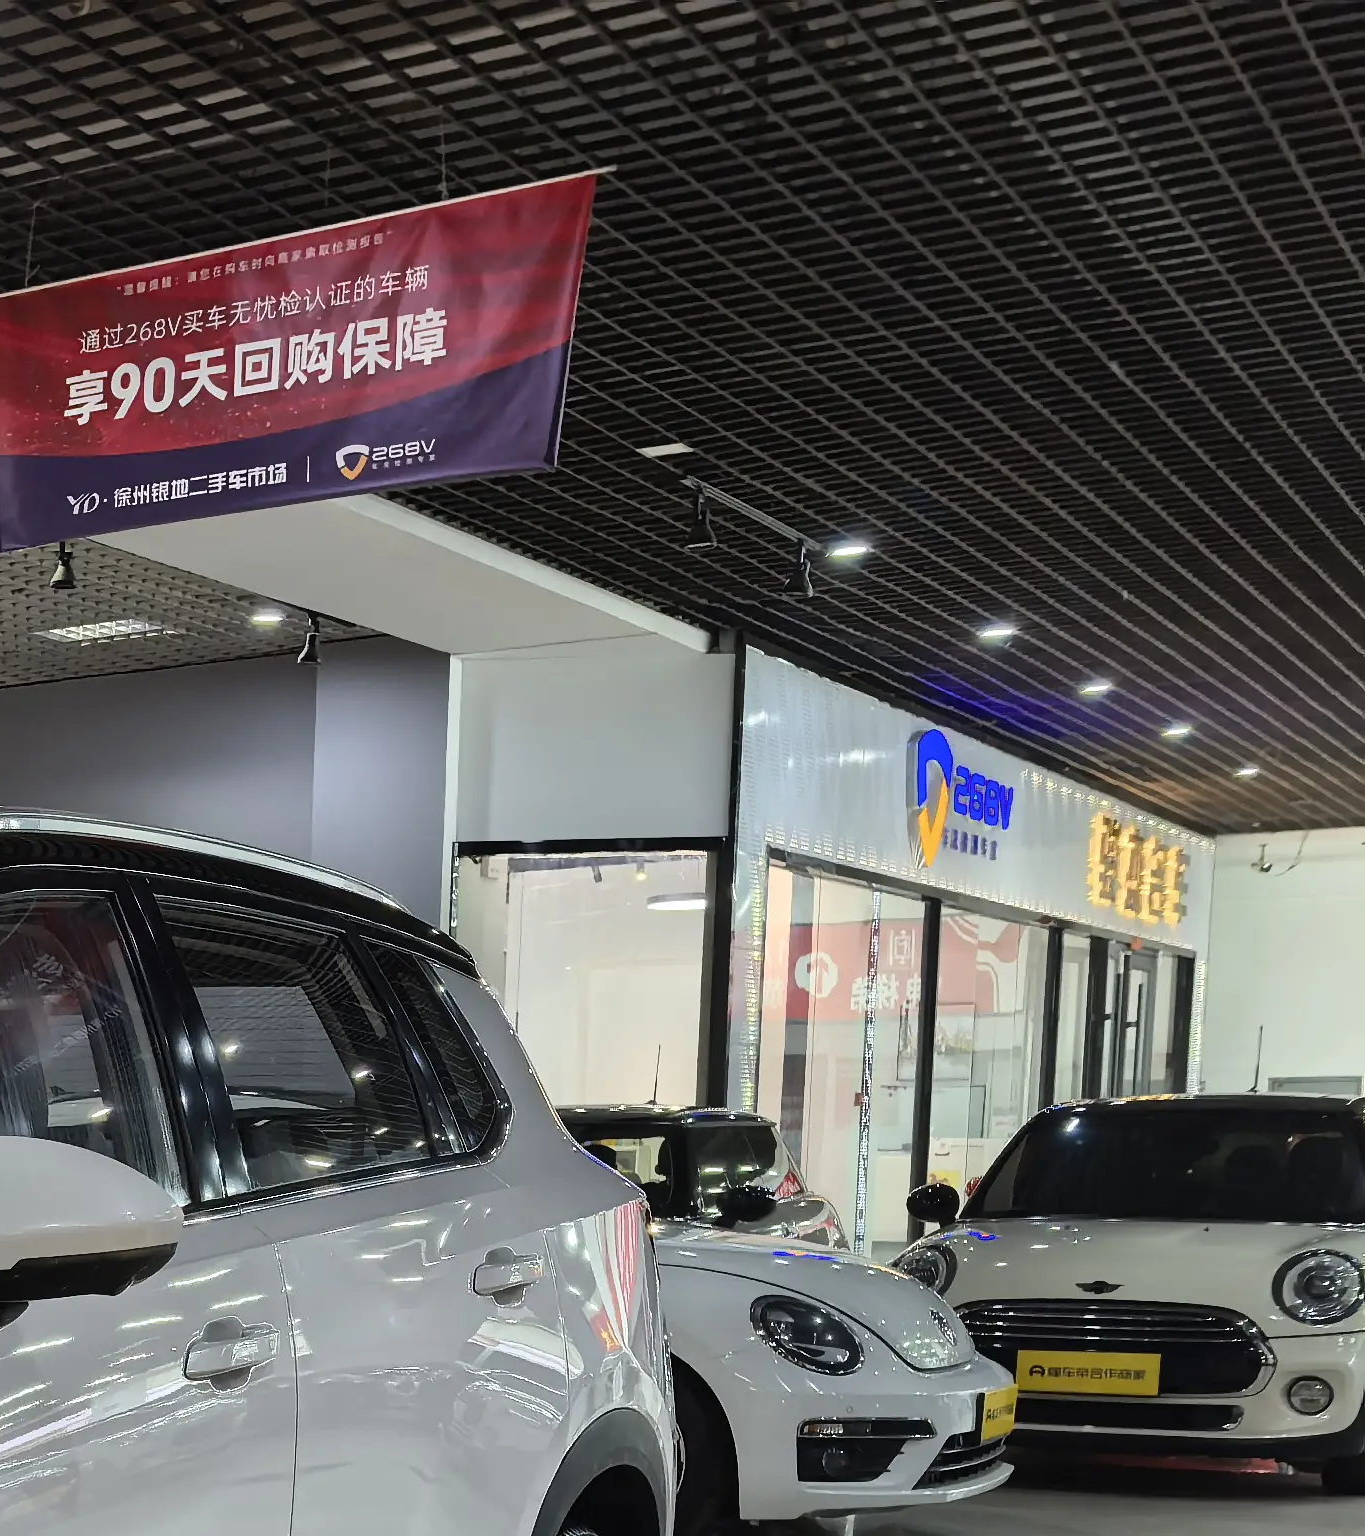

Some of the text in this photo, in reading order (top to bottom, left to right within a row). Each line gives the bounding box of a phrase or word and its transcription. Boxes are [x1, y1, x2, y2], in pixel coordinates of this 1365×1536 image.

[79, 265, 430, 354] 通过268V买车无忧检认证的车辆
[64, 307, 447, 426] 享90天回购保障
[372, 439, 435, 461] 268V
[953, 765, 1014, 830] 268V
